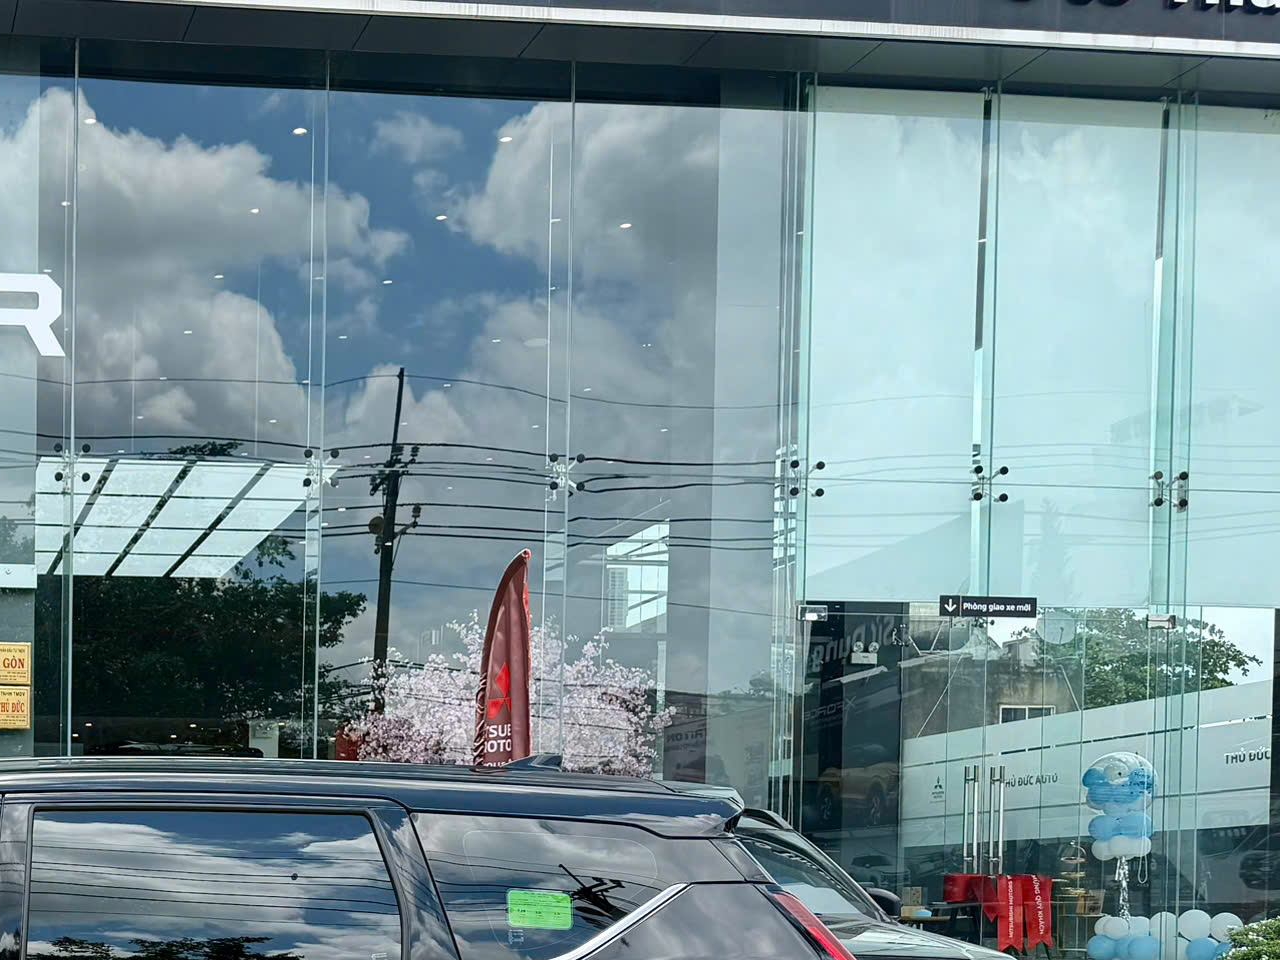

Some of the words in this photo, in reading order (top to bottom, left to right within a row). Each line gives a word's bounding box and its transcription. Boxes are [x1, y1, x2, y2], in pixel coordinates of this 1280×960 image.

[963, 602, 987, 612] Phòng
[988, 603, 1005, 612] giao
[1016, 603, 1031, 612] mới
[3, 655, 25, 669] GÒN
[1224, 746, 1246, 764] THỦ
